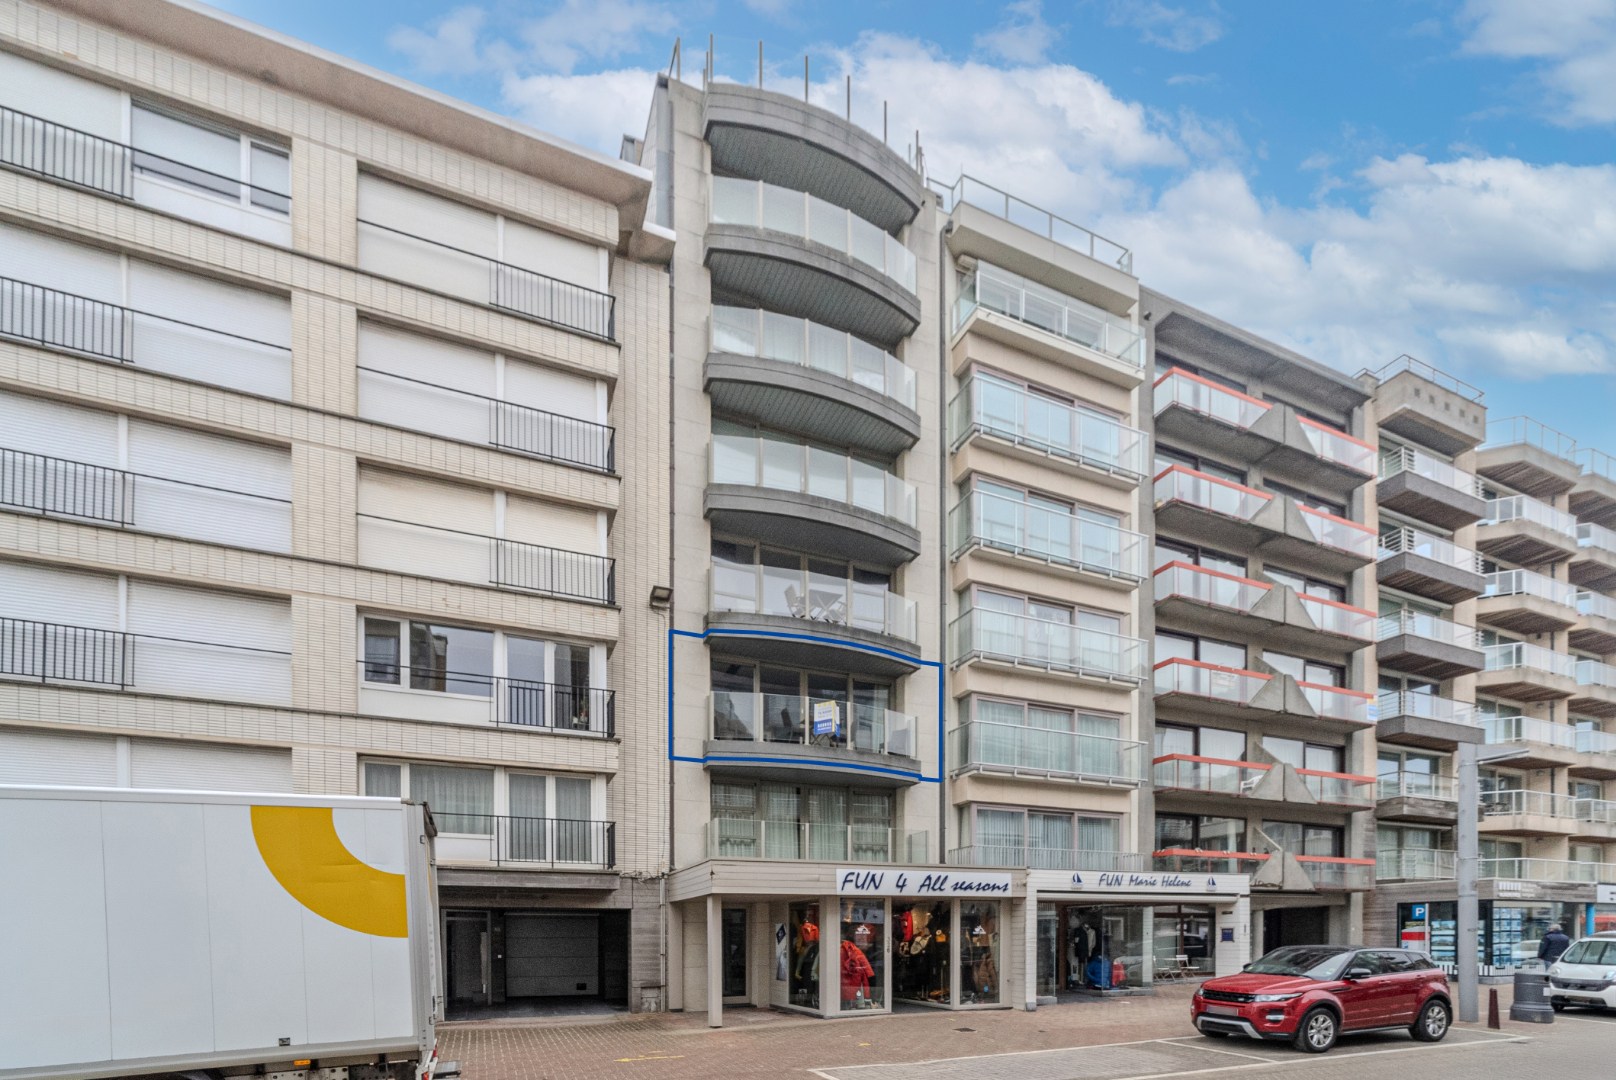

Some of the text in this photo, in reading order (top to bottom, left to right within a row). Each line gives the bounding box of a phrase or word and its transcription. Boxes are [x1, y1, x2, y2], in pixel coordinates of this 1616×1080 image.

[841, 871, 1010, 893] FUN 4 All seasons
[1098, 873, 1192, 888] FUN Marie Helene
[1415, 907, 1425, 917] P
